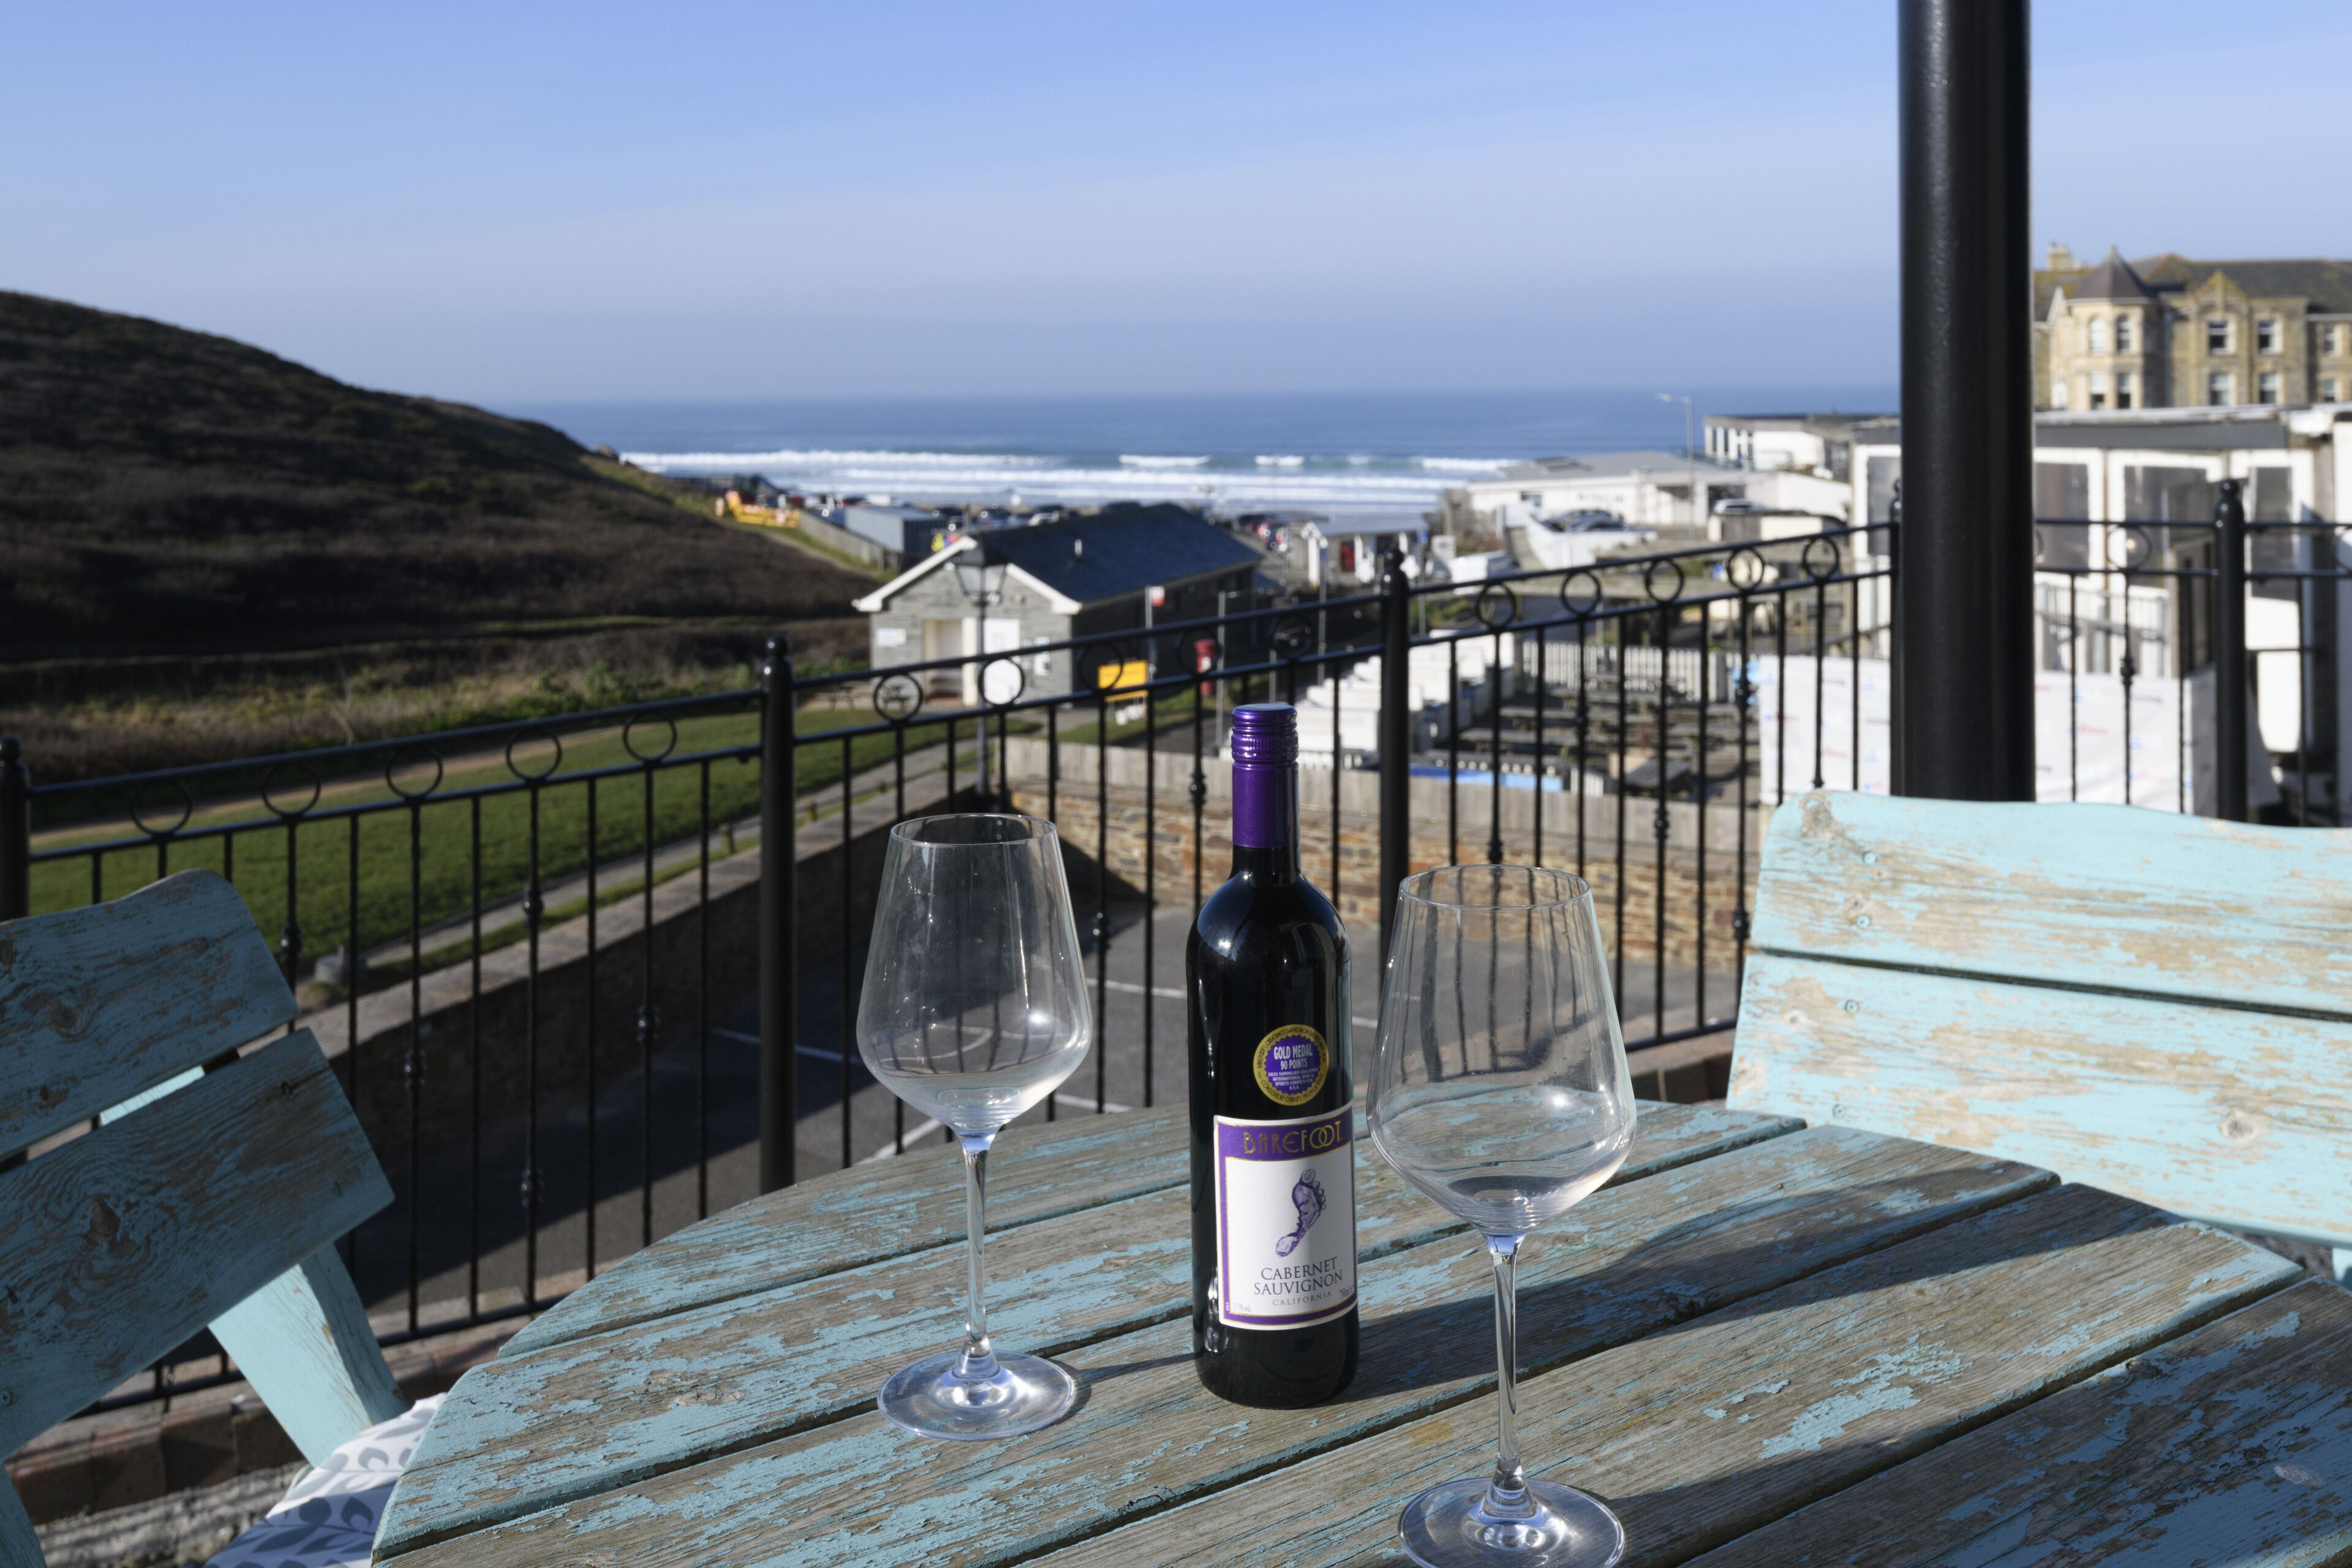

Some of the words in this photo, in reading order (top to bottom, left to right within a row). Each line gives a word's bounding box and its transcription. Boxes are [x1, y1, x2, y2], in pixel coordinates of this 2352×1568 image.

[1274, 1046, 1291, 1060] GOLD
[1292, 1043, 1313, 1058] MEDAL
[1281, 1060, 1288, 1070] 90
[1289, 1058, 1308, 1069] POINTS
[1244, 1120, 1341, 1154] BAREFOOT
[1261, 1256, 1338, 1280] CABERNET
[1254, 1269, 1343, 1295] SAUVIGNON
[1273, 1291, 1332, 1306] CALIFORNIA
